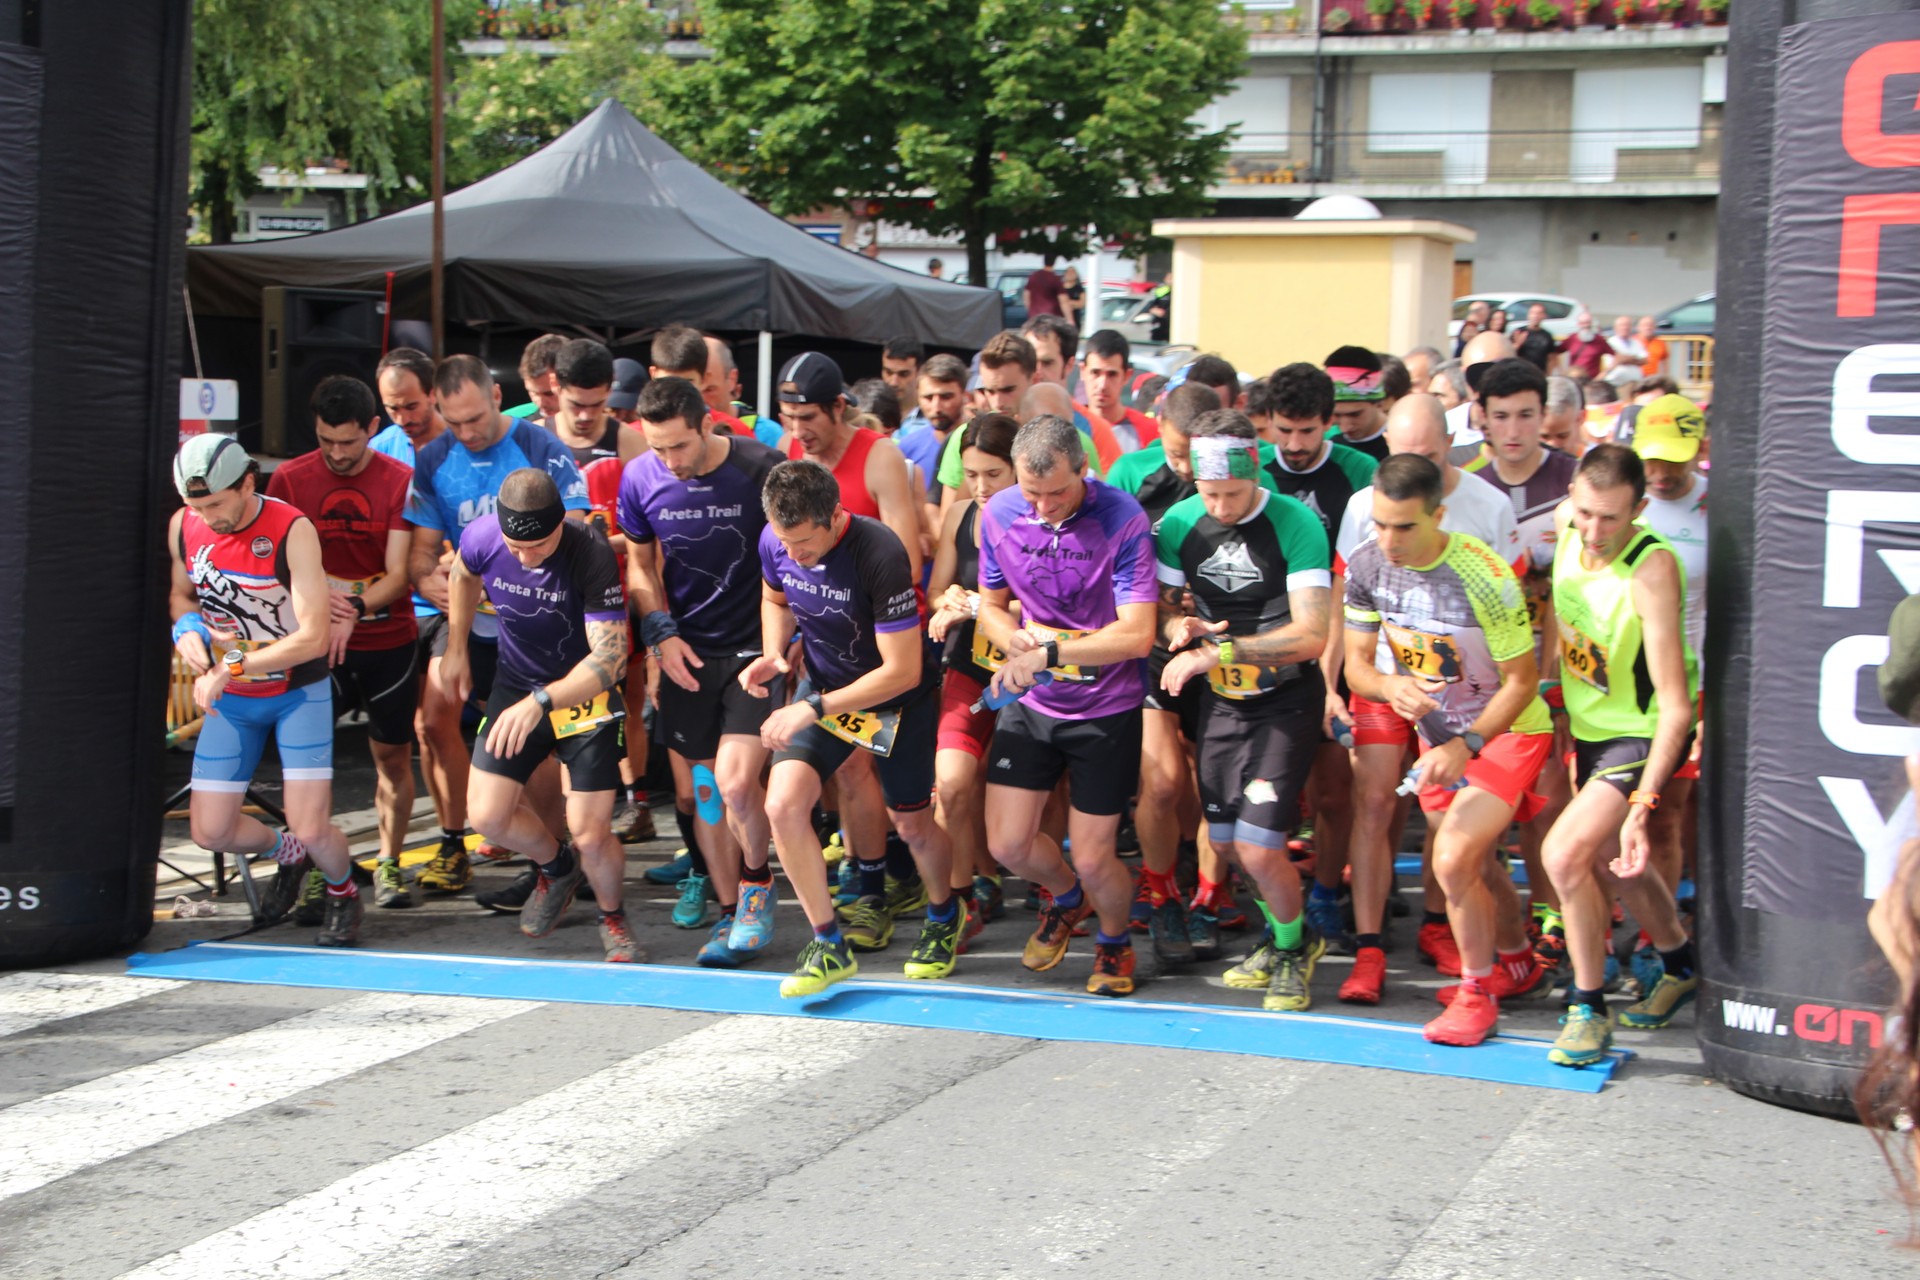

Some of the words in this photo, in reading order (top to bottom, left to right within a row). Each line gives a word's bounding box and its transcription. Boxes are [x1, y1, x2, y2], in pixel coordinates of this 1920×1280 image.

[658, 508, 703, 521] Areta
[706, 504, 743, 518] Trail
[1061, 548, 1094, 561] Trail
[492, 577, 531, 597] Areta
[534, 587, 567, 603] Trail
[782, 573, 818, 595] Areta
[820, 584, 851, 602] Trail
[1402, 648, 1426, 669] 87
[1568, 648, 1589, 672] 40
[1220, 667, 1242, 687] 13
[836, 712, 866, 734] 45
